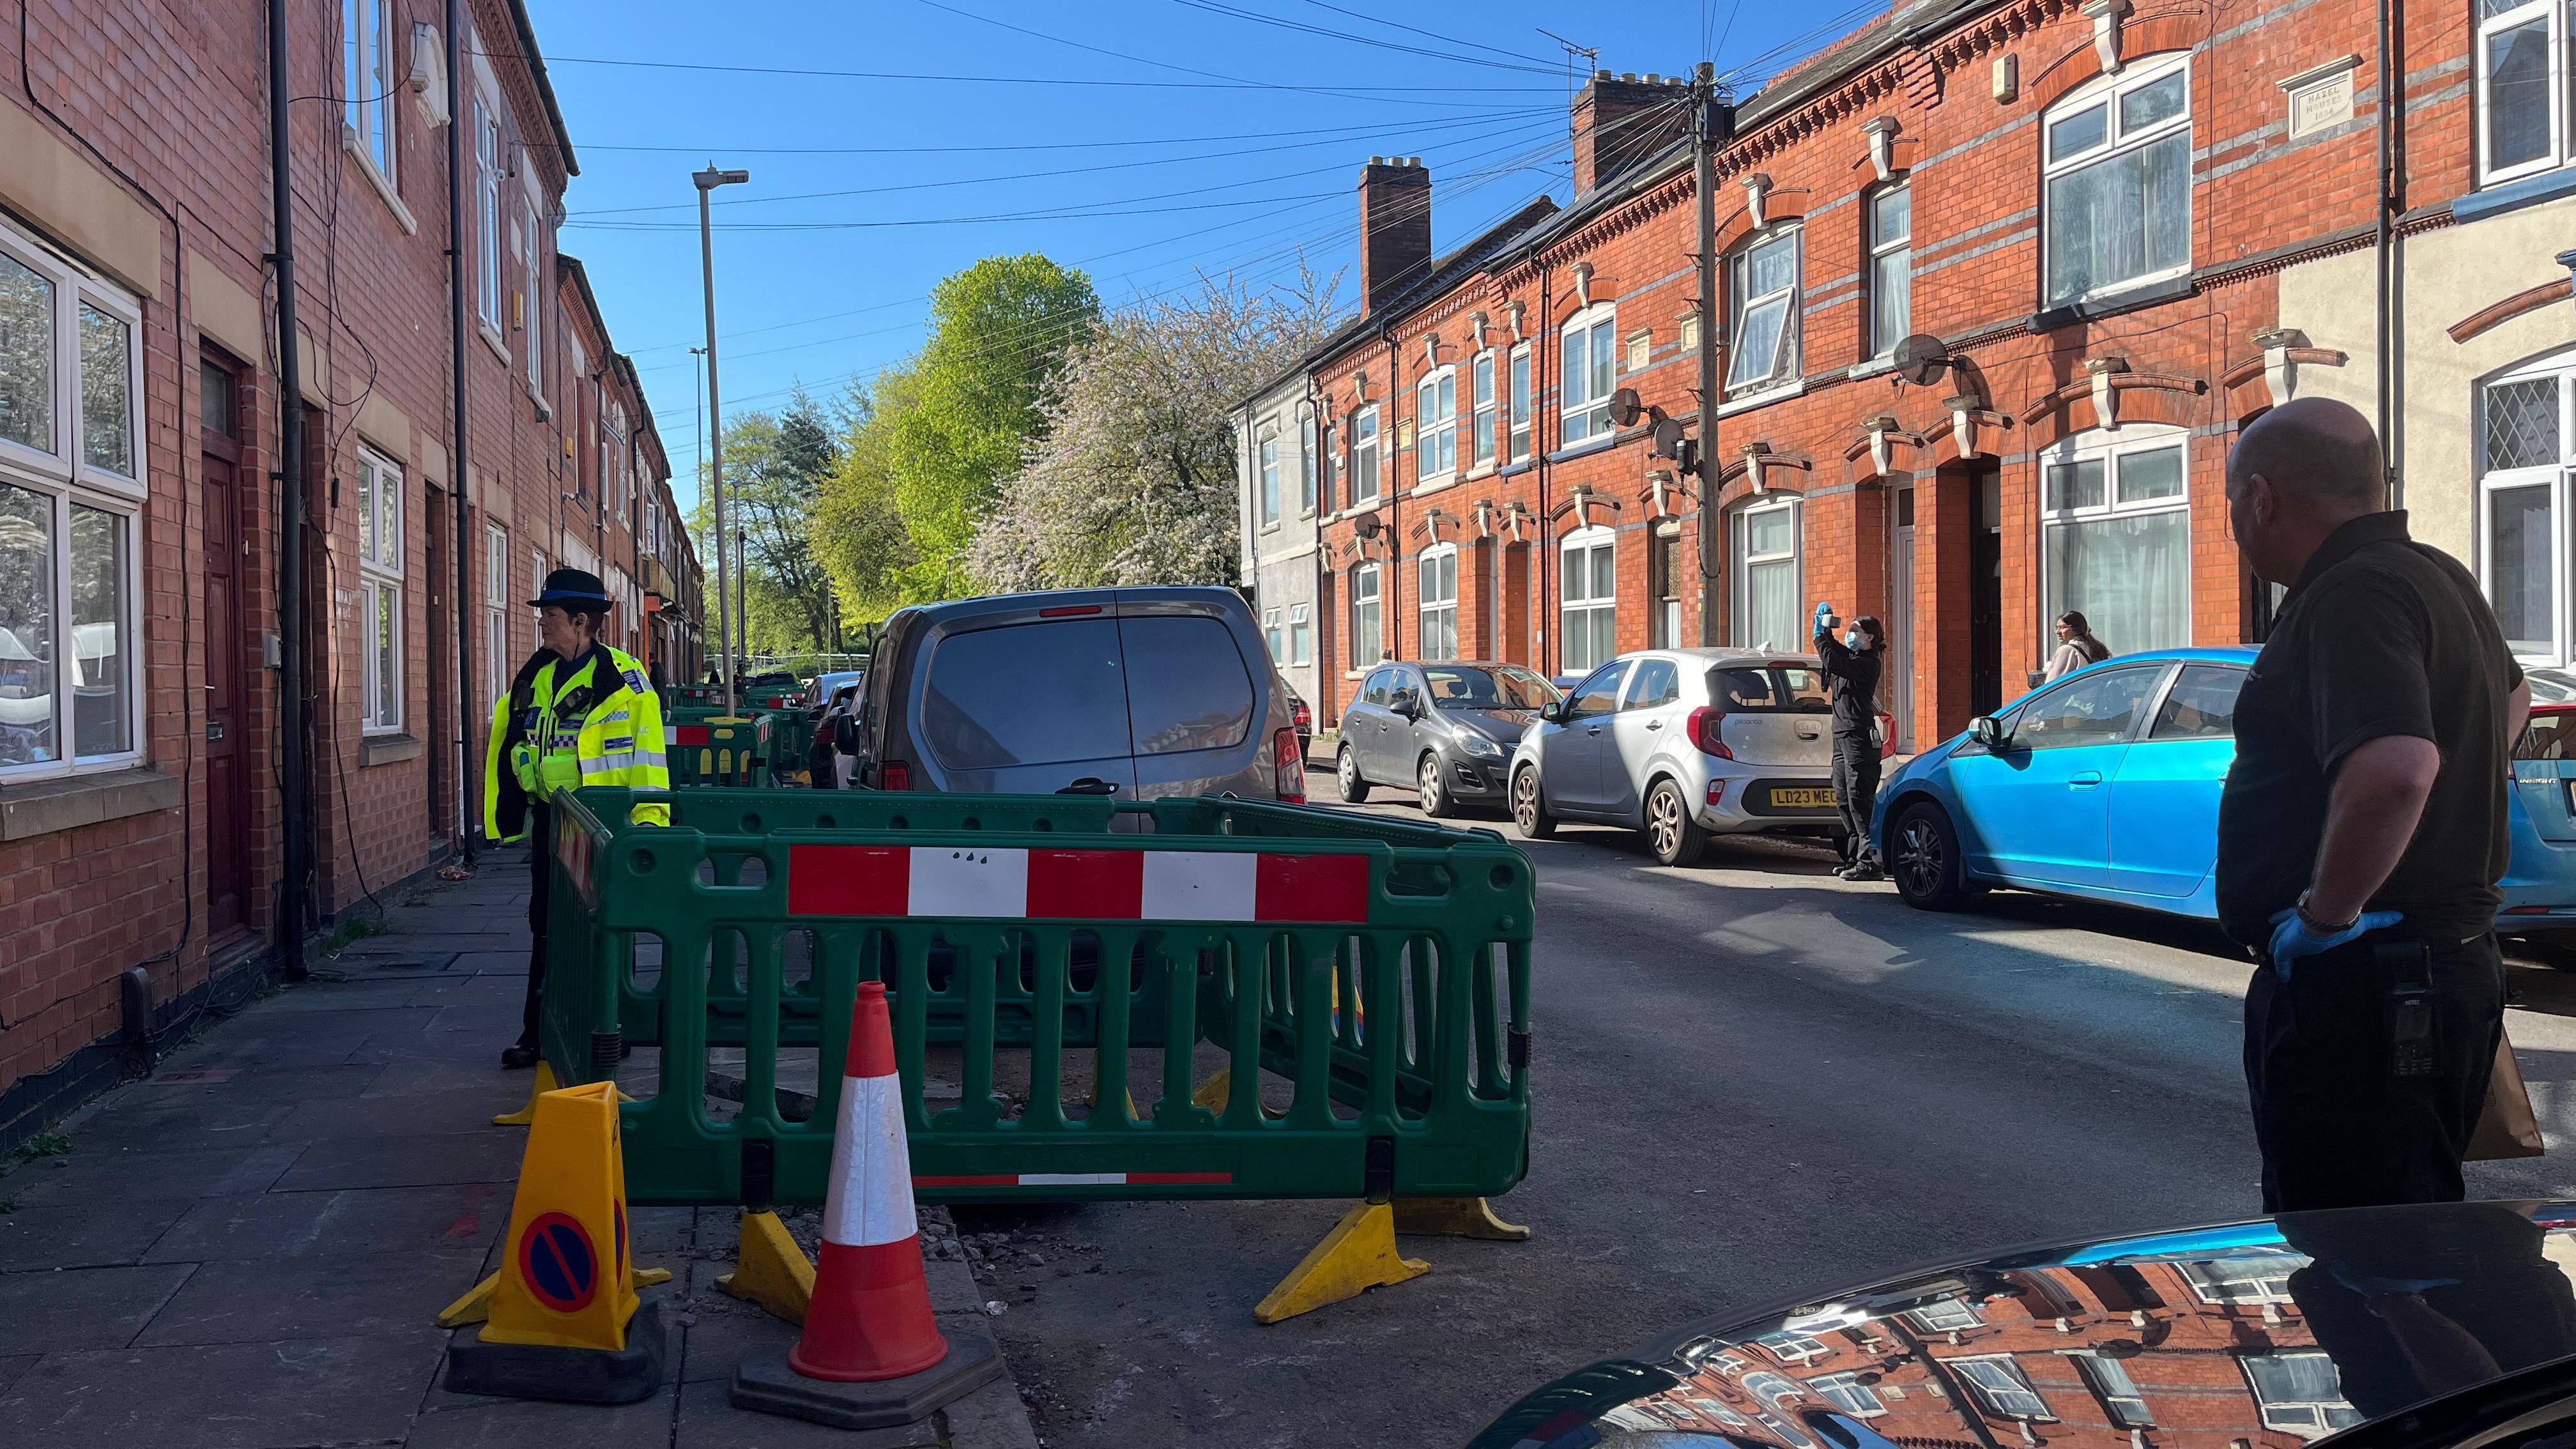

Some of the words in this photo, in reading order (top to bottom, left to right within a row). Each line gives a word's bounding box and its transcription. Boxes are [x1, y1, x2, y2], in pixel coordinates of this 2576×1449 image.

[2308, 86, 2340, 103] HAZEL
[2306, 95, 2341, 114] HOUSES
[1776, 790, 1810, 803] LD23
